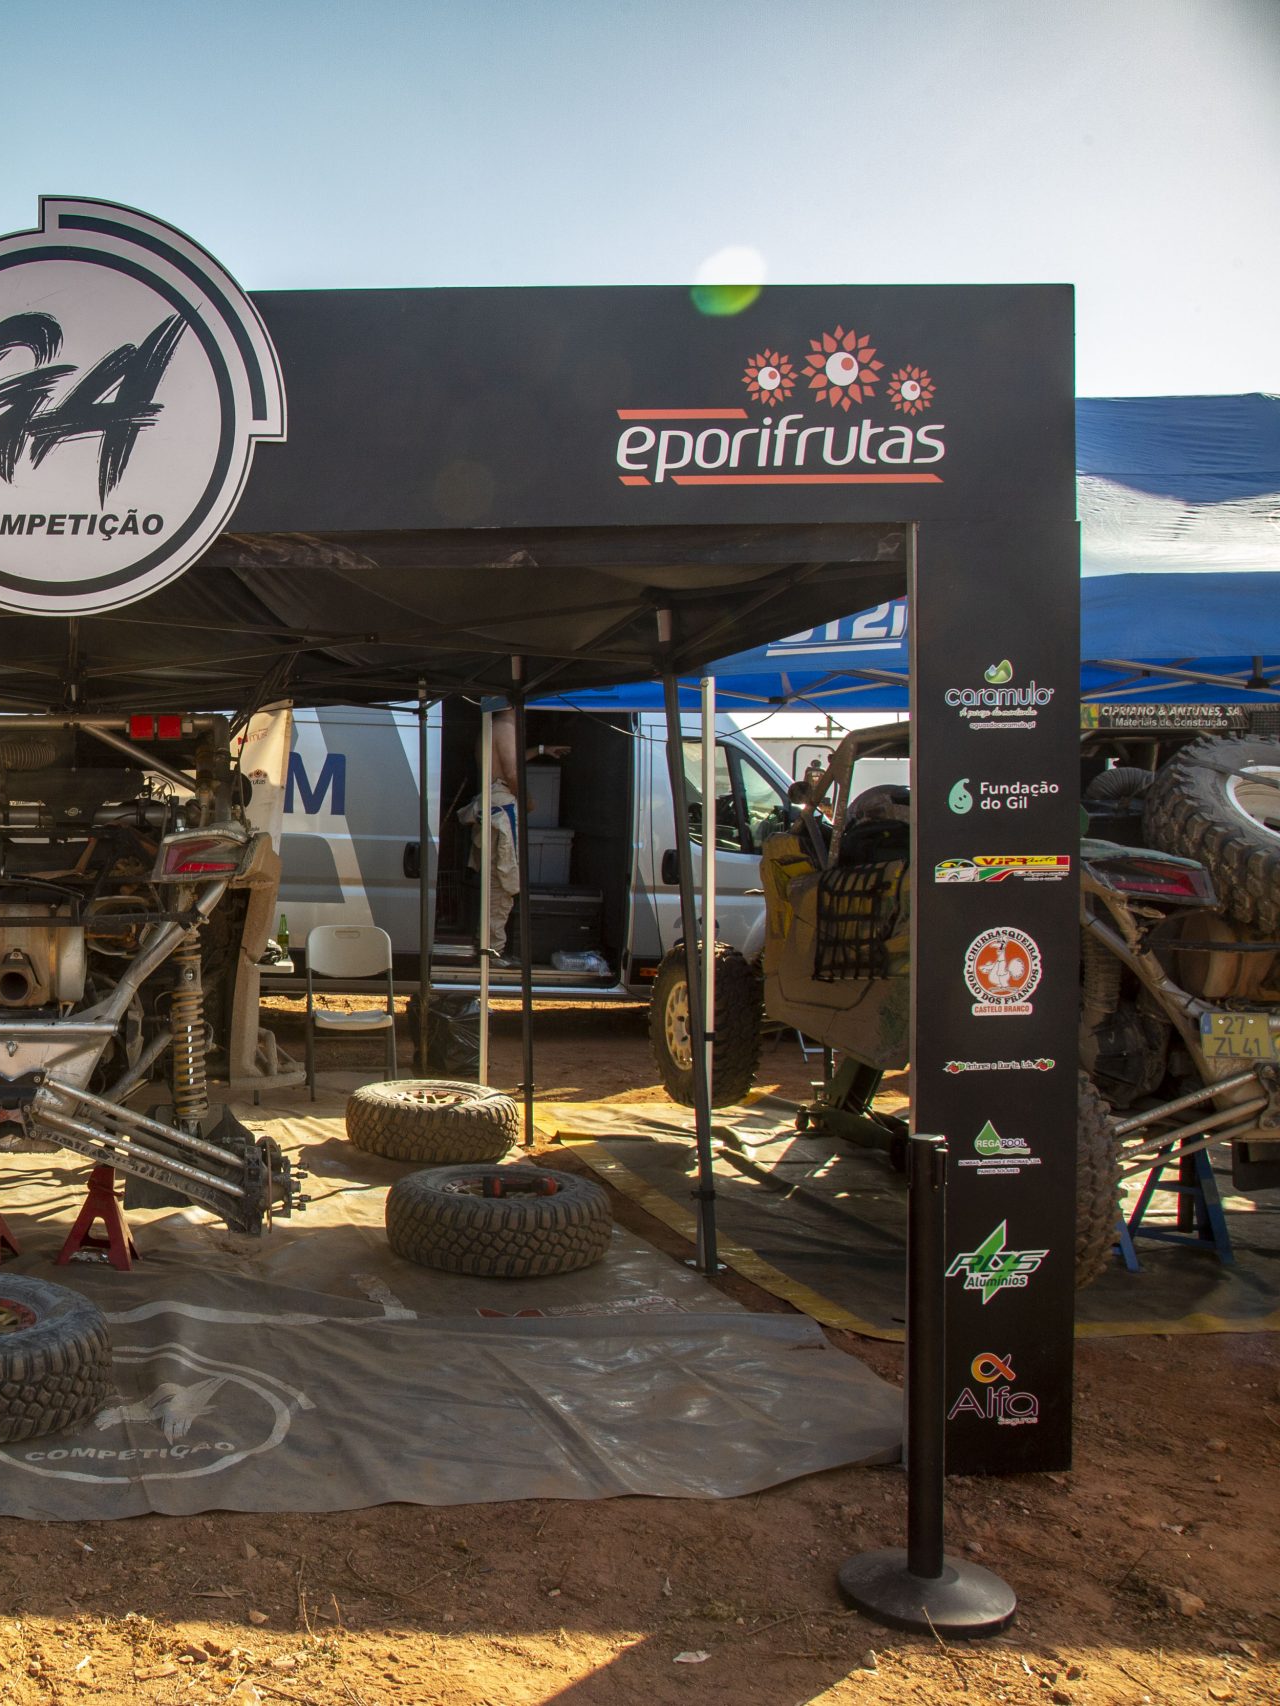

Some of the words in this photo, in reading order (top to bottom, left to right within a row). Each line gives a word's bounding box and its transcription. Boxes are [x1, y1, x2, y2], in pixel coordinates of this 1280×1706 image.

[616, 414, 946, 483] eporifrutas
[945, 681, 1054, 706] caramulo
[1116, 717, 1157, 727] Materiais
[1174, 717, 1228, 728] Construção
[980, 781, 1059, 797] Fundação
[980, 797, 1001, 810] do
[1006, 796, 1027, 809] Gil
[968, 930, 1038, 961] CHURRASQUEIRA
[981, 994, 1001, 1005] DOS
[1005, 969, 1039, 1004] FRANGOS
[1224, 1016, 1245, 1034] 27
[1214, 1038, 1240, 1056] ZL
[1243, 1038, 1261, 1056] 41
[976, 1139, 1028, 1148] REGAPOOL
[948, 1386, 1038, 1419] Alfa
